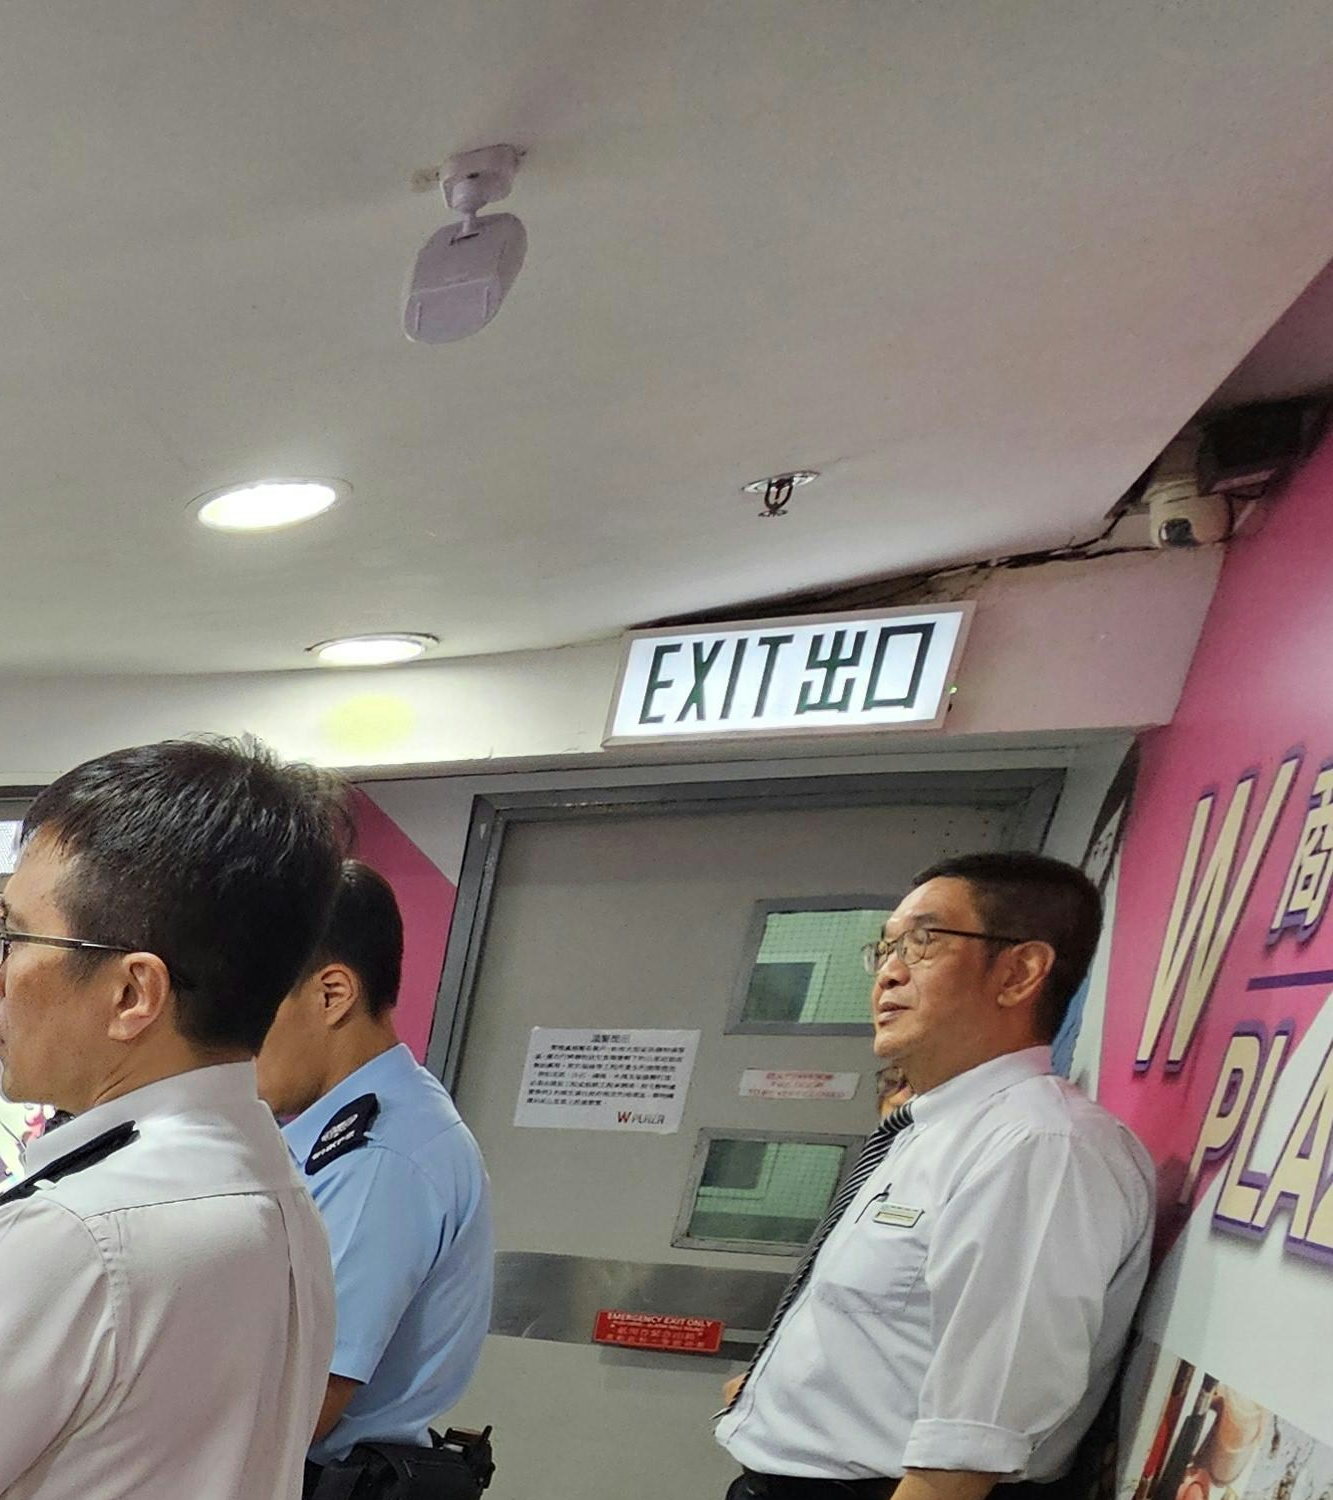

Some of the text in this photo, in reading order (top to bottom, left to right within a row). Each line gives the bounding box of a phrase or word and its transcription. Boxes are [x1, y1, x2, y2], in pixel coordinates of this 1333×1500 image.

[638, 621, 937, 725] EXIT 出口
[1133, 755, 1300, 1070] W
[617, 1110, 632, 1124] W
[607, 1312, 663, 1324] EMERGENCY
[663, 1316, 686, 1326] EXIT
[687, 1318, 714, 1328] ONLY
